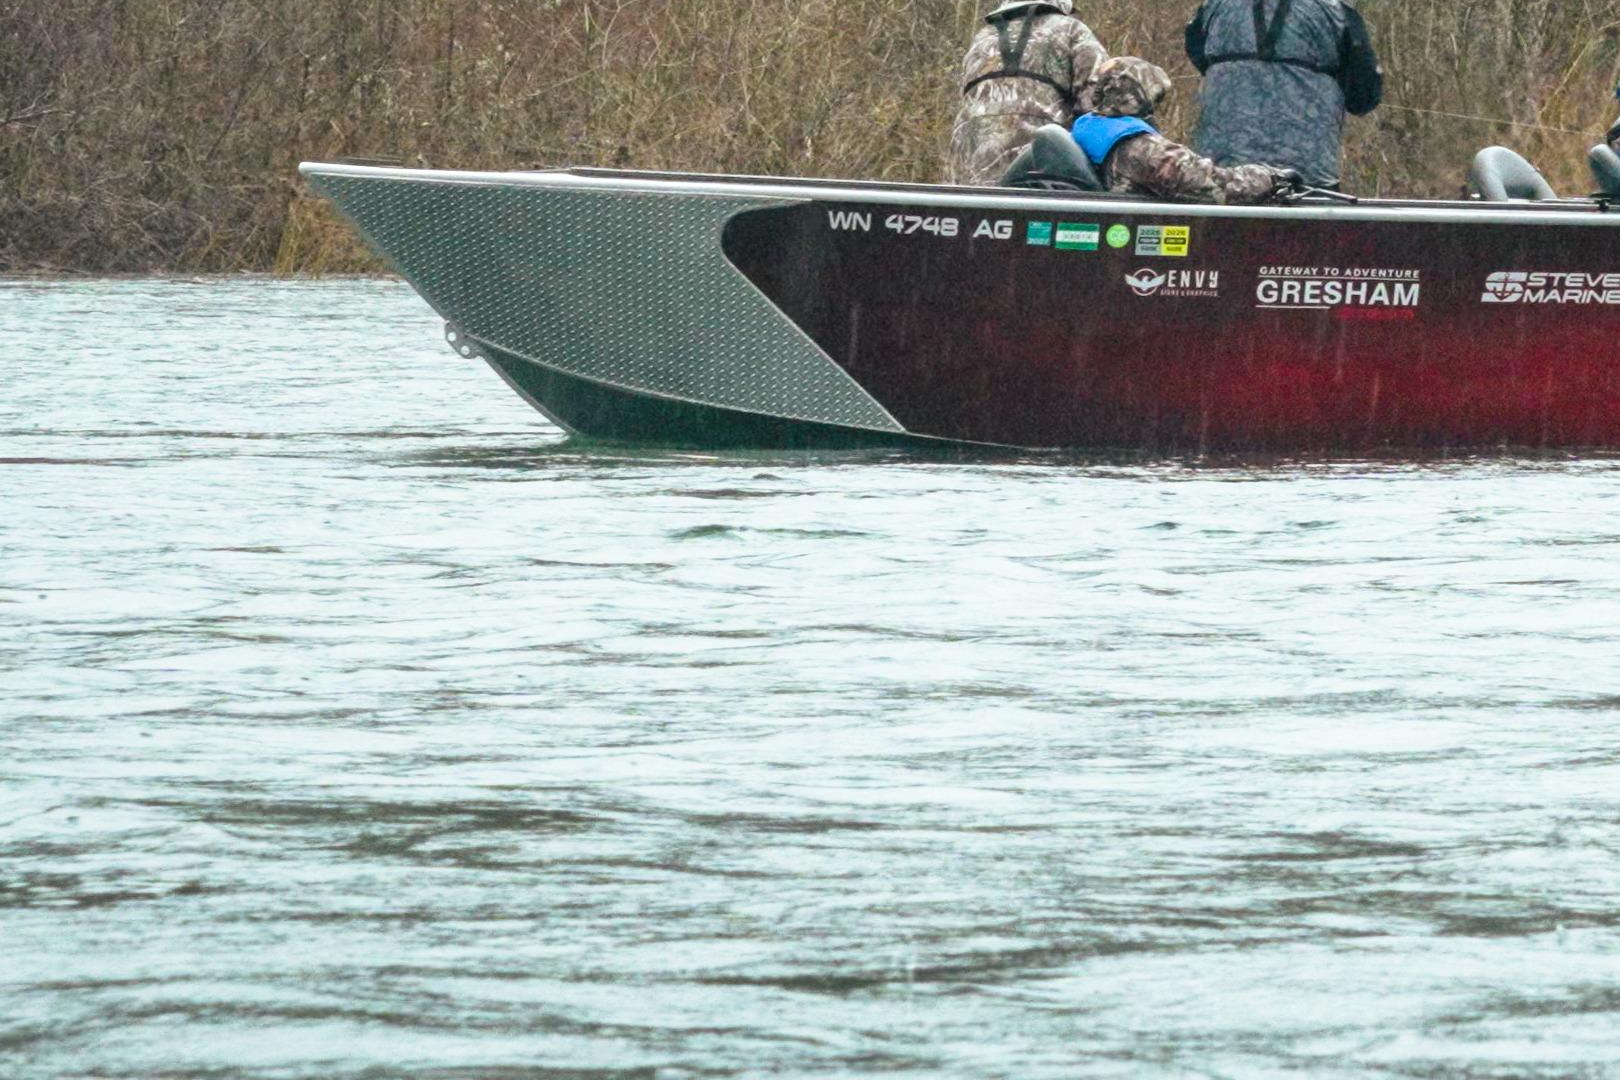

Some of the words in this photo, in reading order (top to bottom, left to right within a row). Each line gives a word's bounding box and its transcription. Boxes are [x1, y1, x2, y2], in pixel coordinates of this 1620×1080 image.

[828, 210, 872, 232] WN
[885, 214, 959, 236] 4748
[972, 219, 1013, 240] AG
[1167, 269, 1219, 289] ENVY
[1259, 266, 1319, 276] GATEWAY
[1323, 267, 1340, 276] TO
[1344, 268, 1420, 279] ADVENTURE
[1256, 279, 1420, 307] GRESHAM
